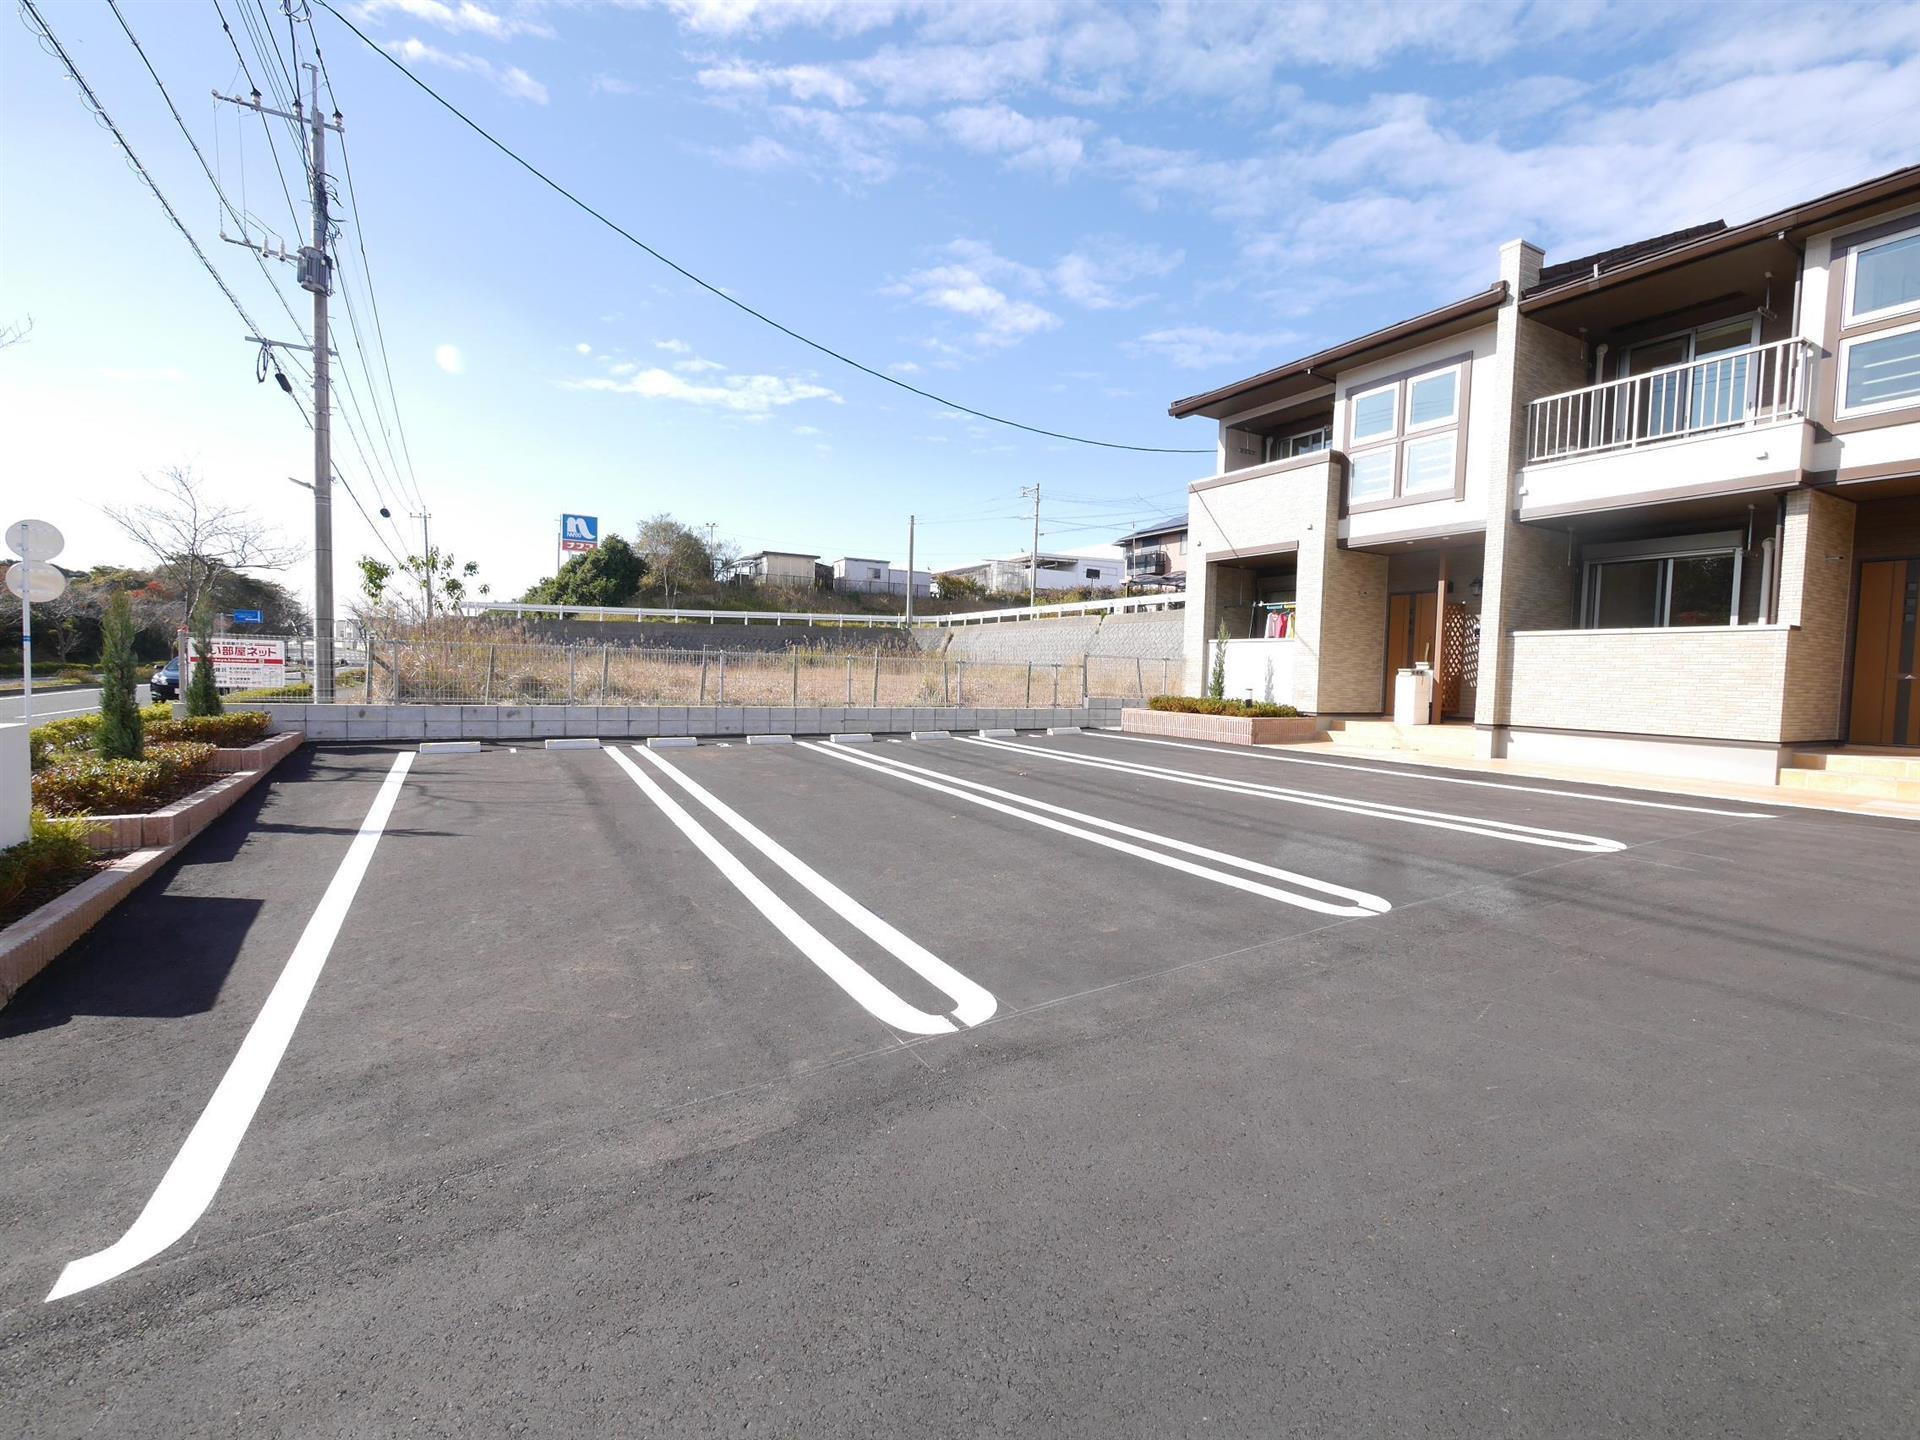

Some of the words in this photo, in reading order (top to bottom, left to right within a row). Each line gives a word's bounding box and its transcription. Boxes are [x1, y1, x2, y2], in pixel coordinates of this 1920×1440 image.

[210, 646, 277, 657] い部屋ネット
